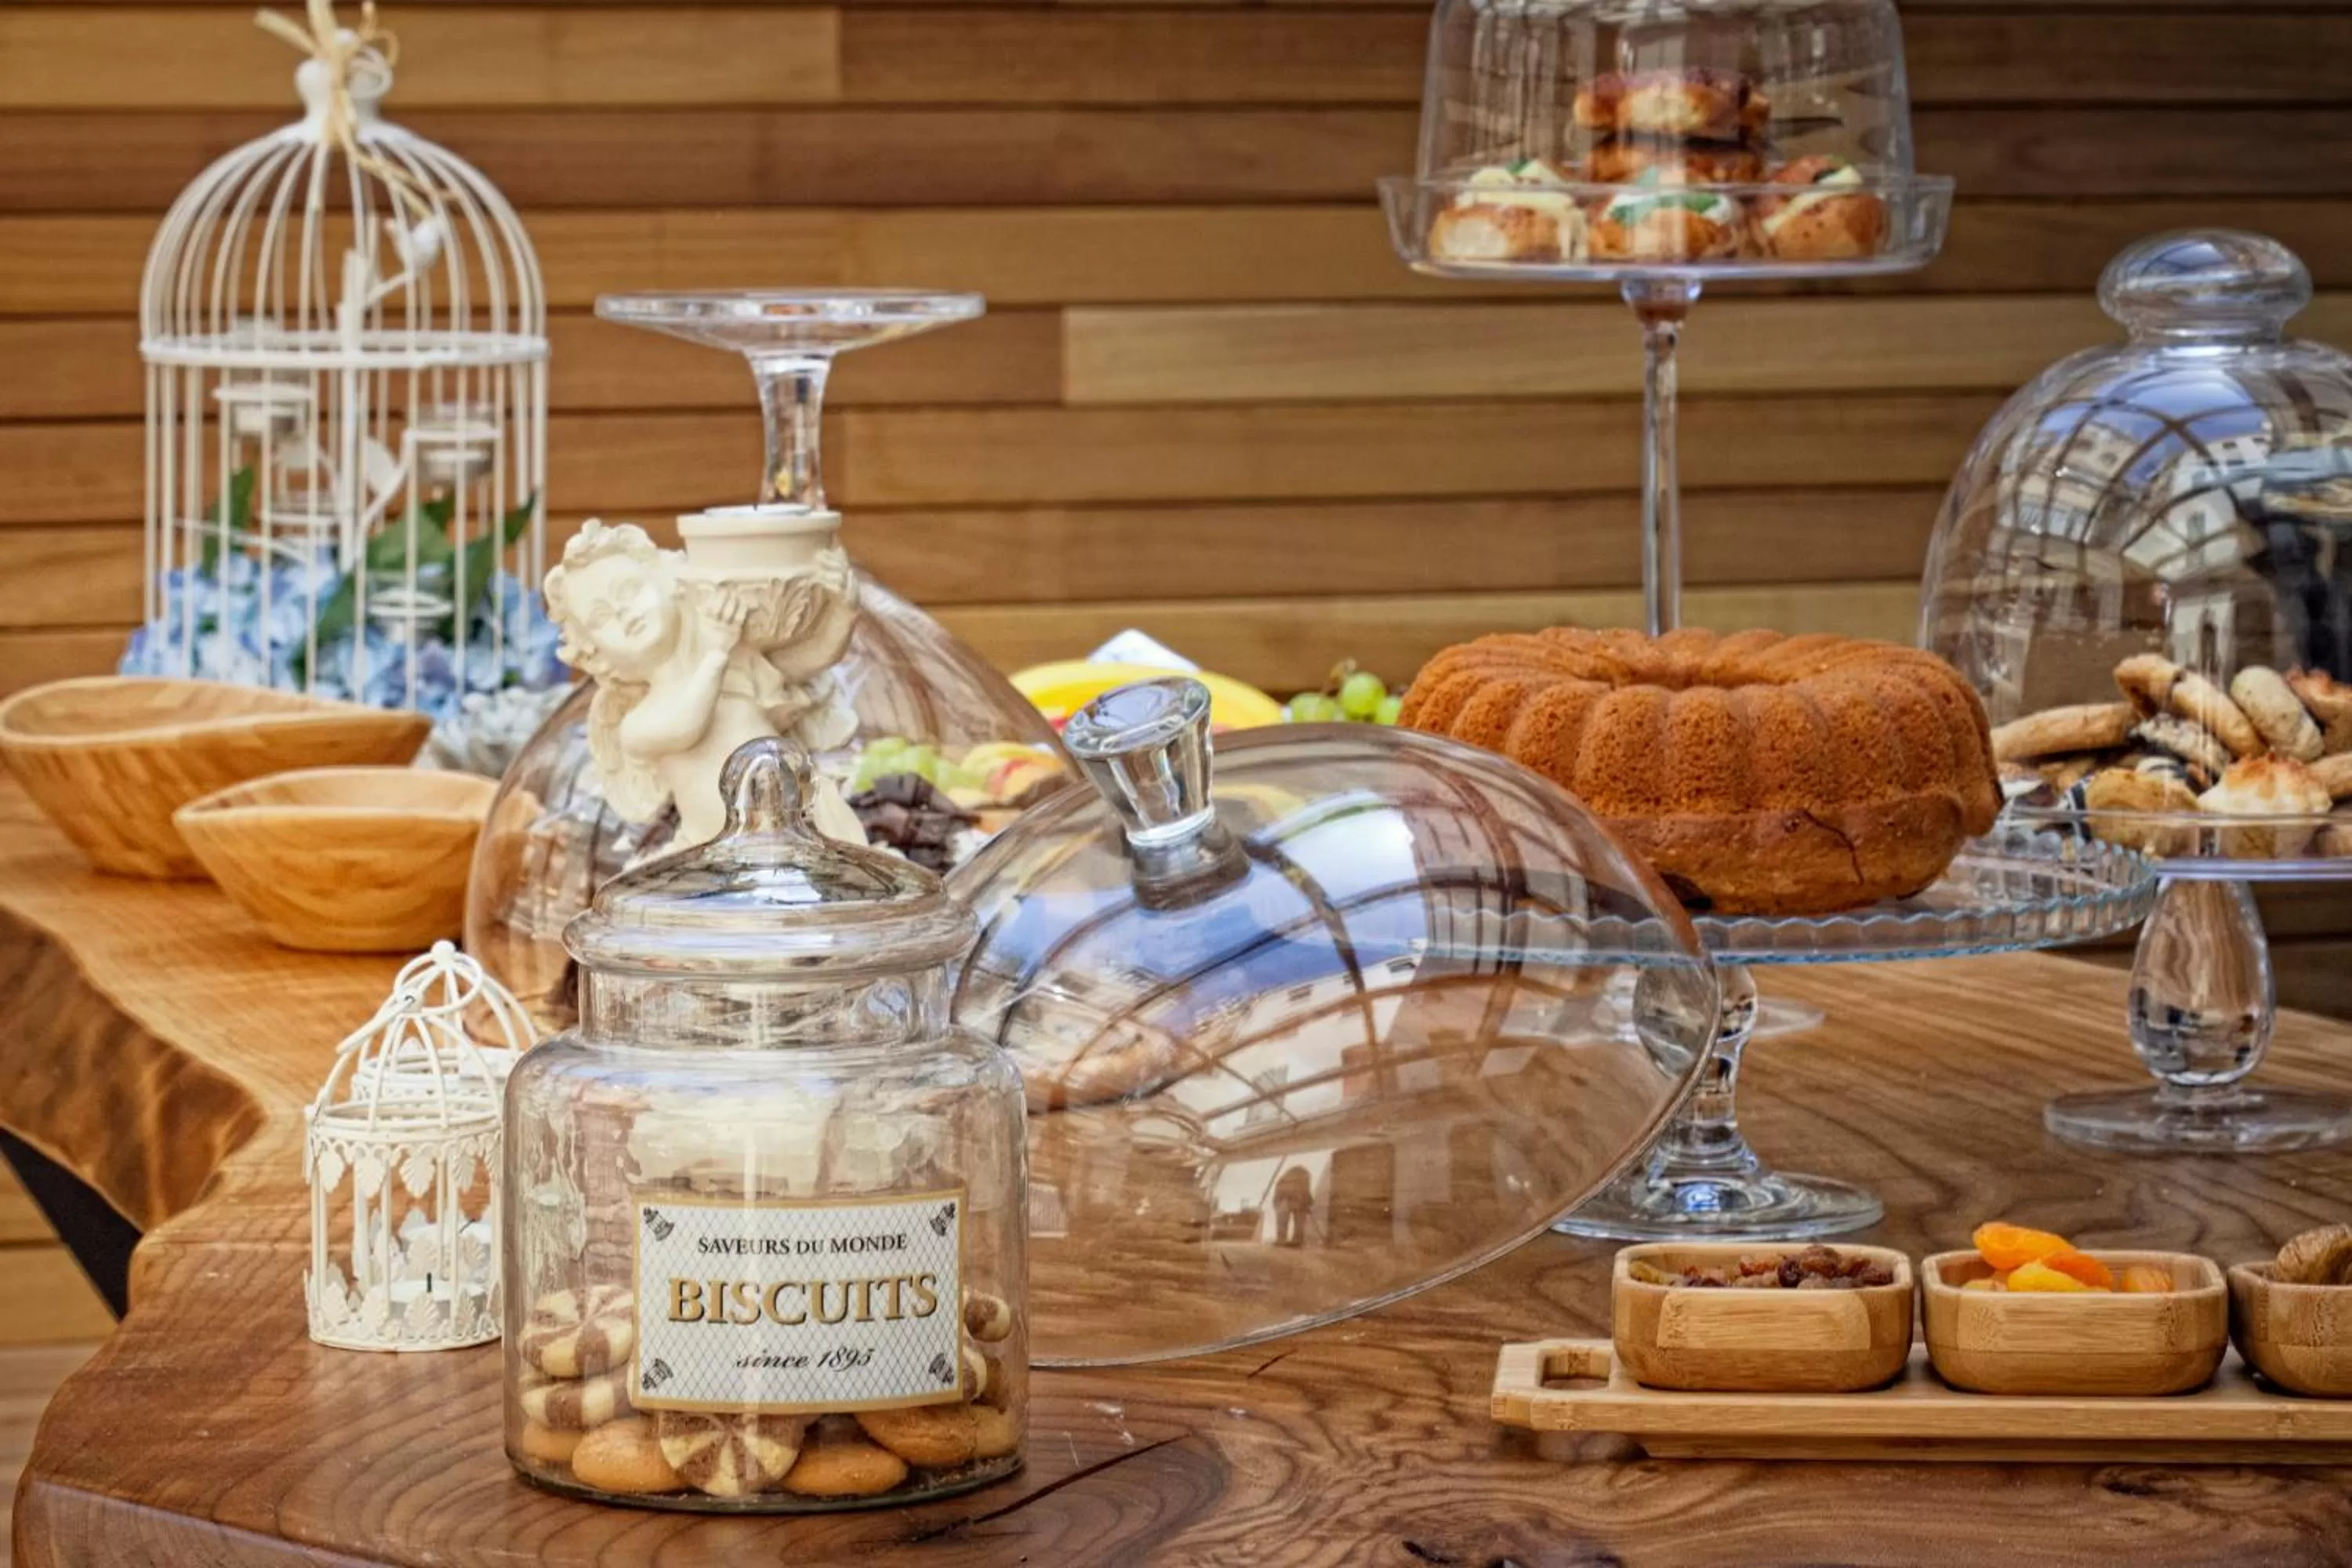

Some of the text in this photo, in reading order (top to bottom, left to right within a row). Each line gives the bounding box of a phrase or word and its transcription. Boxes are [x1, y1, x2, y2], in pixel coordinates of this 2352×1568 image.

[698, 1233, 907, 1254] SAVEURS DU MONDE
[667, 1273, 938, 1326] BISCUITS
[735, 1346, 875, 1373] since 1895
